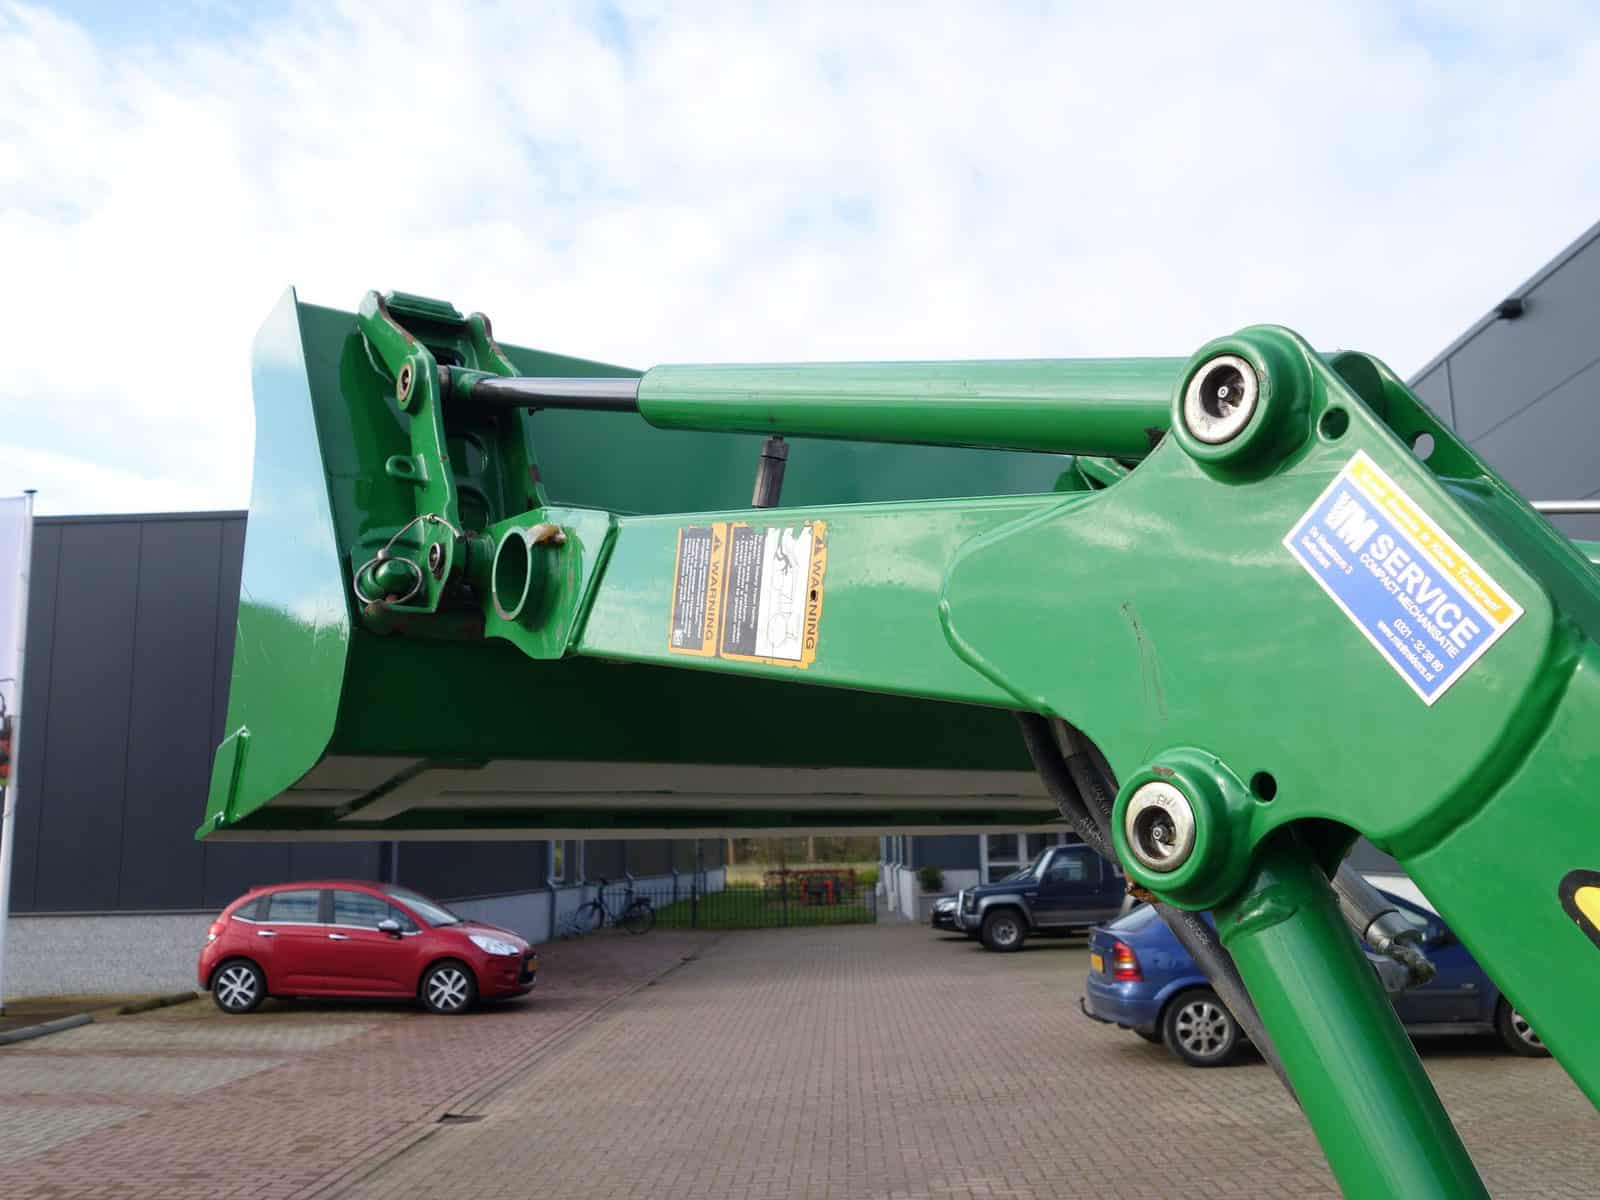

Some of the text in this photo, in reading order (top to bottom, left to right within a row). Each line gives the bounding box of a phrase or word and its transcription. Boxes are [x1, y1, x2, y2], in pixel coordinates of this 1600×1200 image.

[705, 562, 720, 640] WARNING
[1359, 551, 1401, 596] COMPACT
[1395, 590, 1460, 659] MECHANISATIE
[1367, 532, 1482, 650] SERVICE
[1391, 616, 1413, 640] 0321
[1411, 637, 1426, 654] 32
